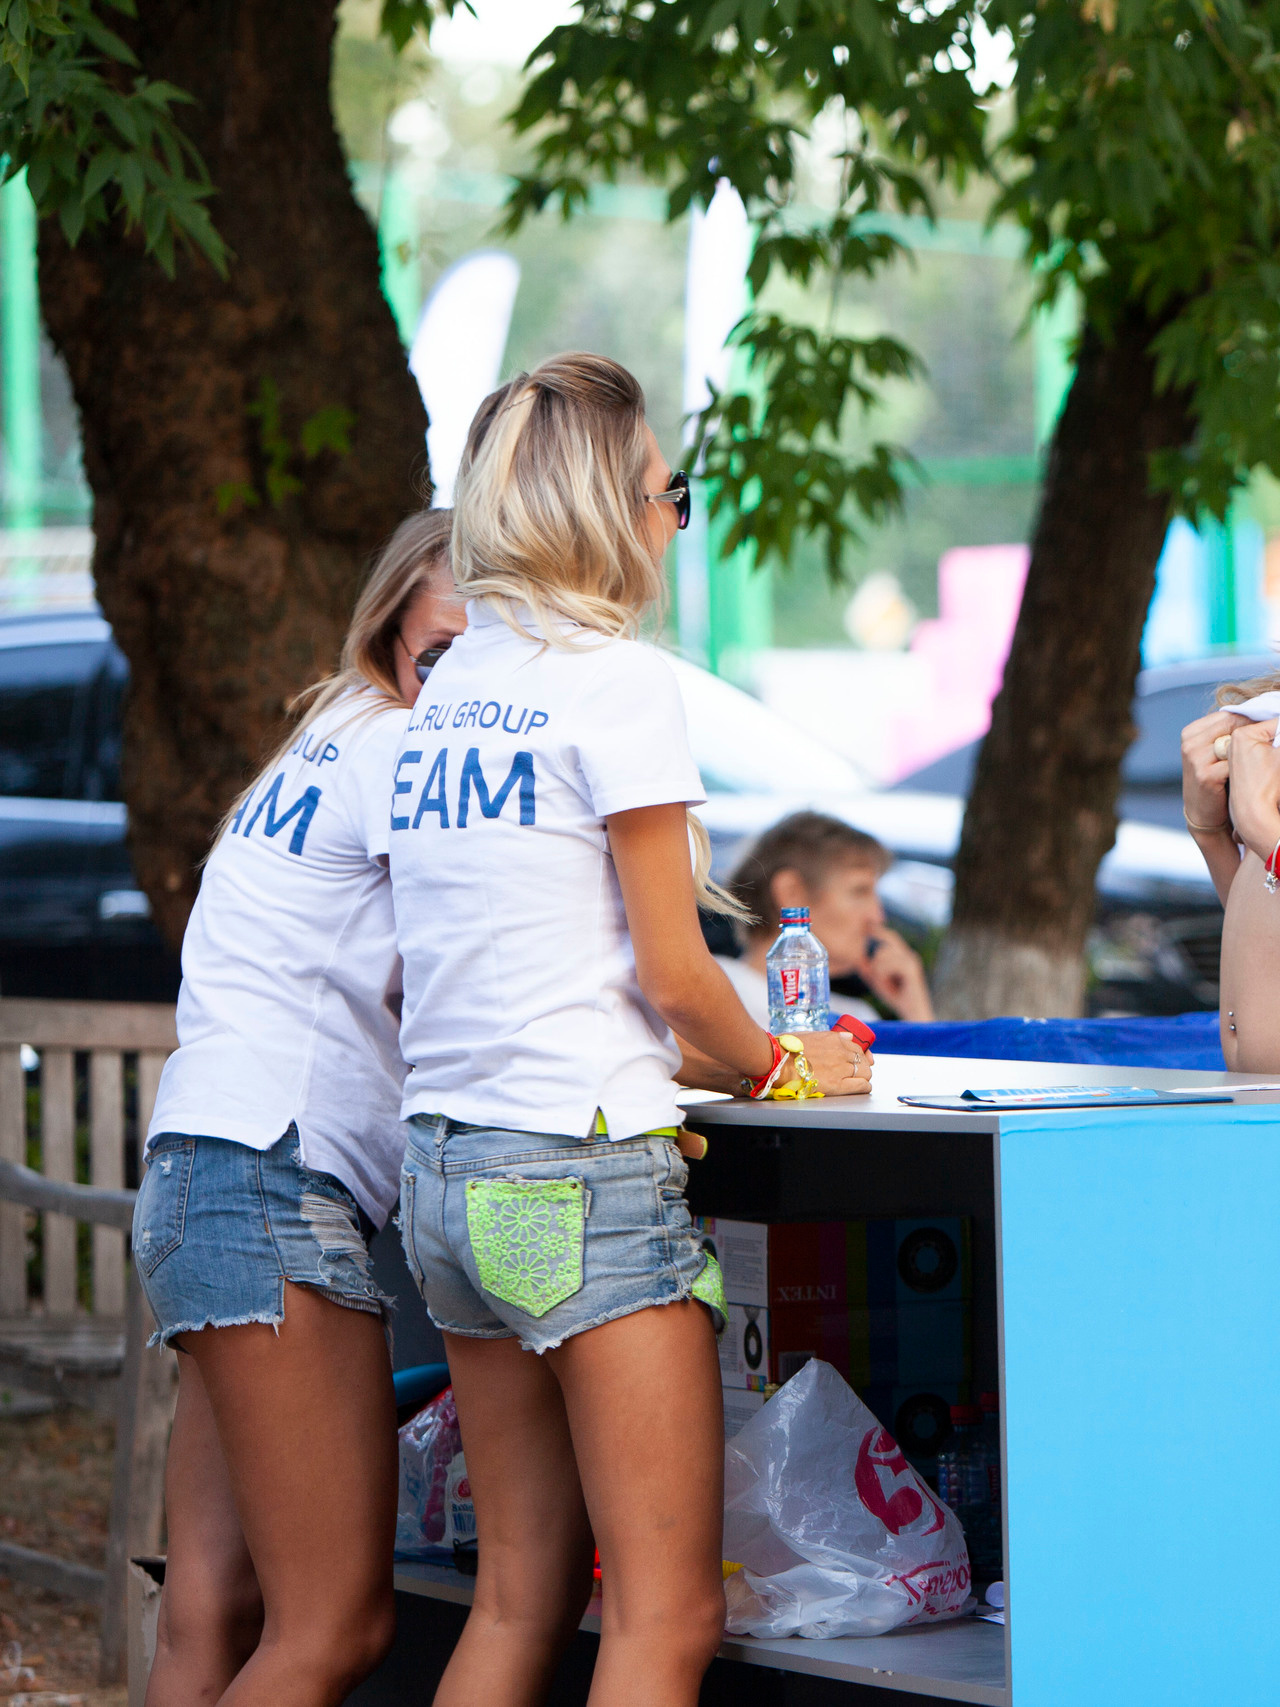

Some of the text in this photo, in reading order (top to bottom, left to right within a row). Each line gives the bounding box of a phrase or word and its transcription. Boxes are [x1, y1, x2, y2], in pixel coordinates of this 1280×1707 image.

[452, 700, 550, 735] GROUP
[784, 971, 796, 1003] Vittel
[776, 1286, 837, 1302] INTEX
